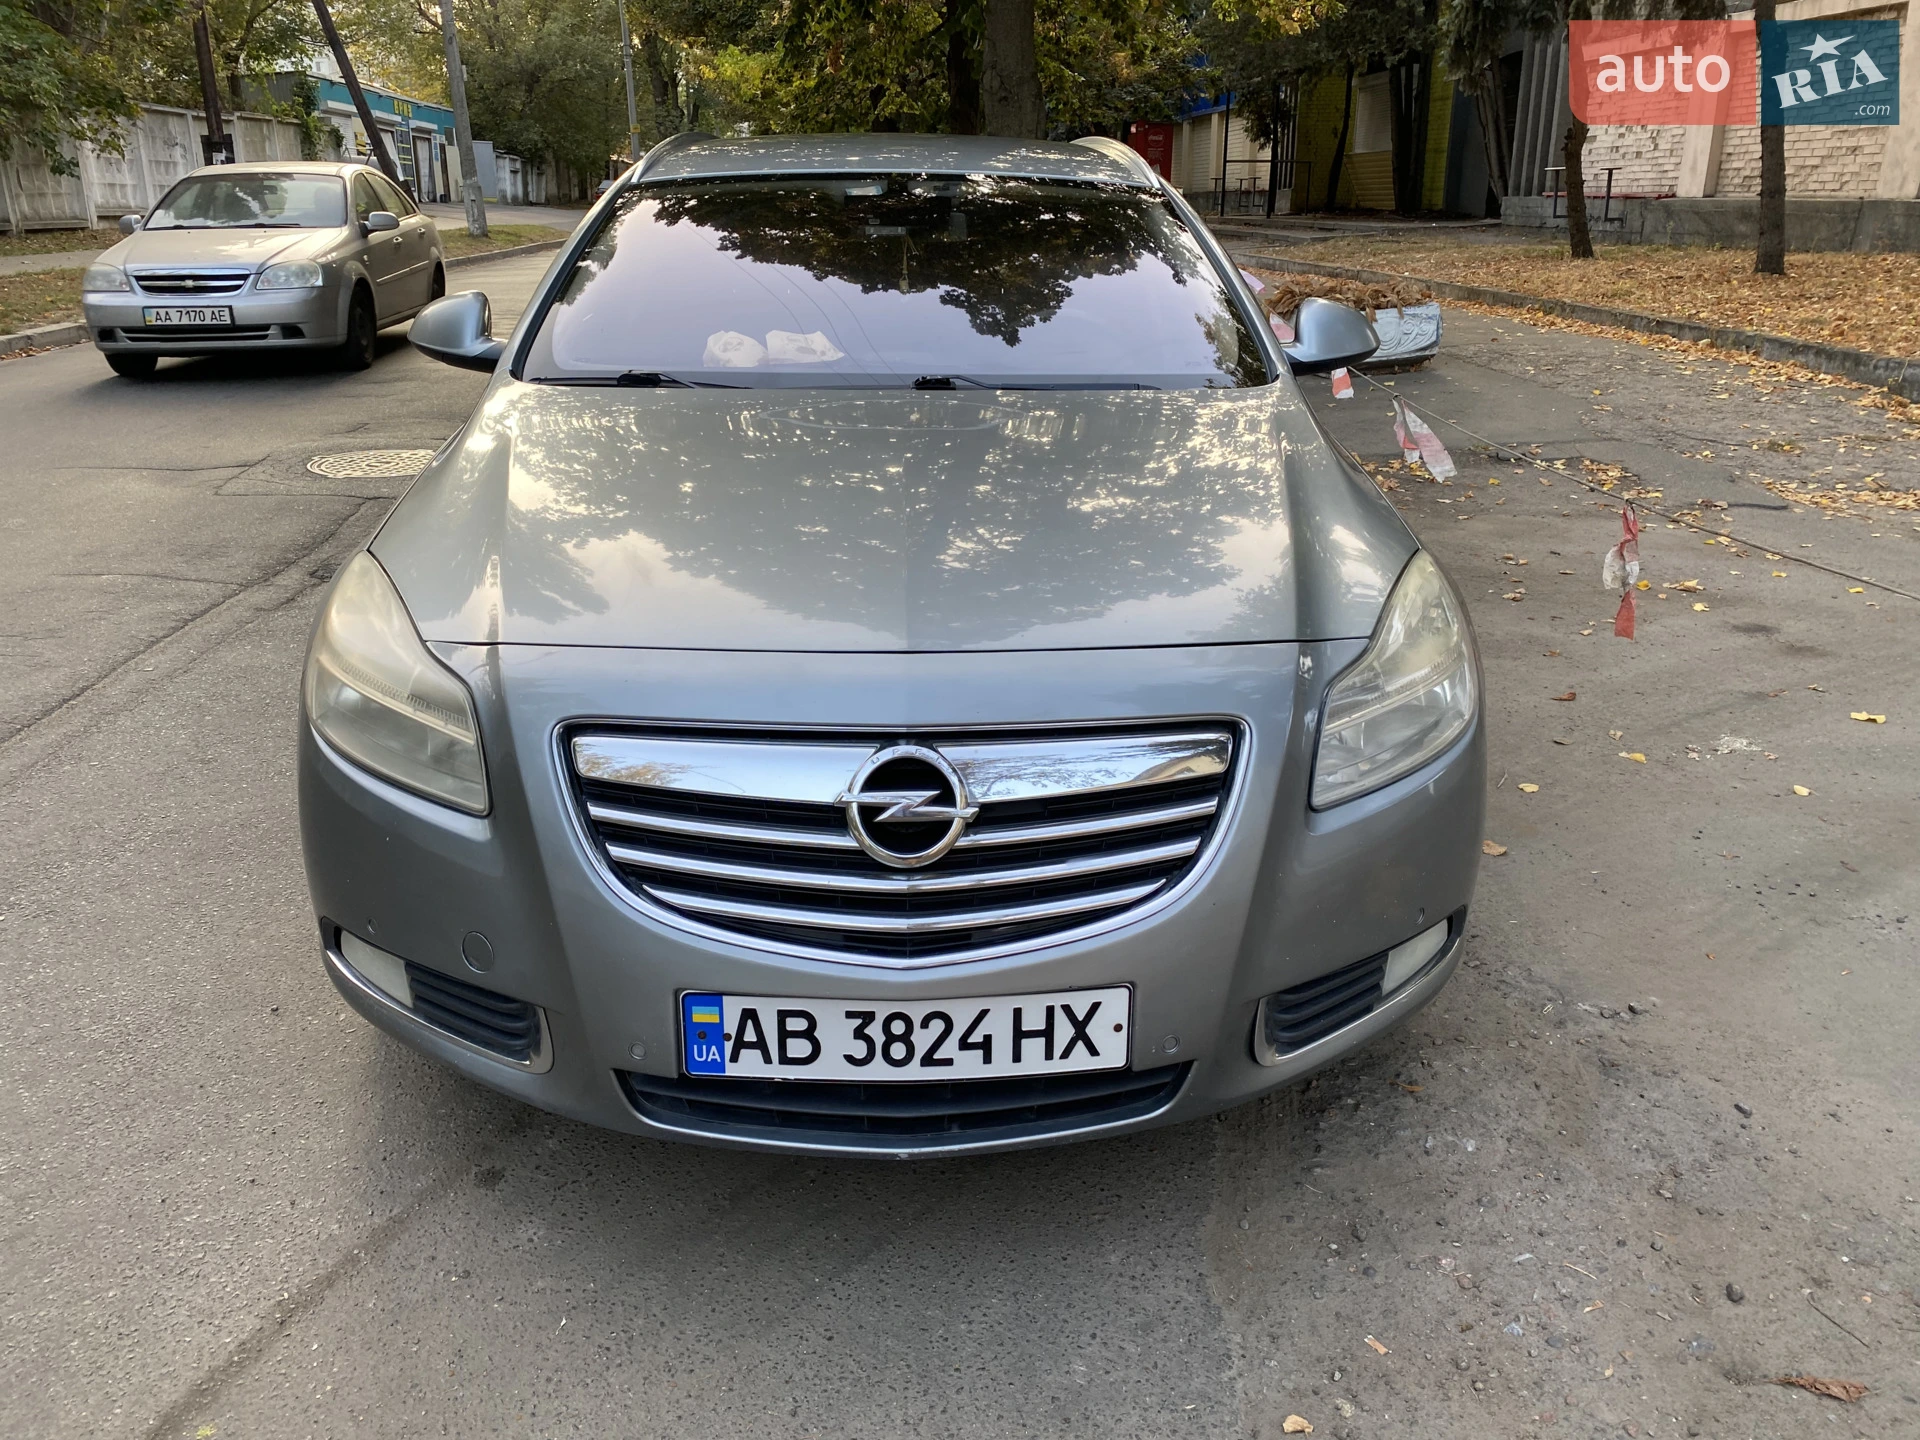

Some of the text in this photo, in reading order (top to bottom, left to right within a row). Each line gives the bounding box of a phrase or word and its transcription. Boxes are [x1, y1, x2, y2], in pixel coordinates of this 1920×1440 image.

[155, 310, 227, 323] AA 7170 AE
[729, 1001, 1103, 1067] AB 3824 HX
[693, 1044, 721, 1063] UA
